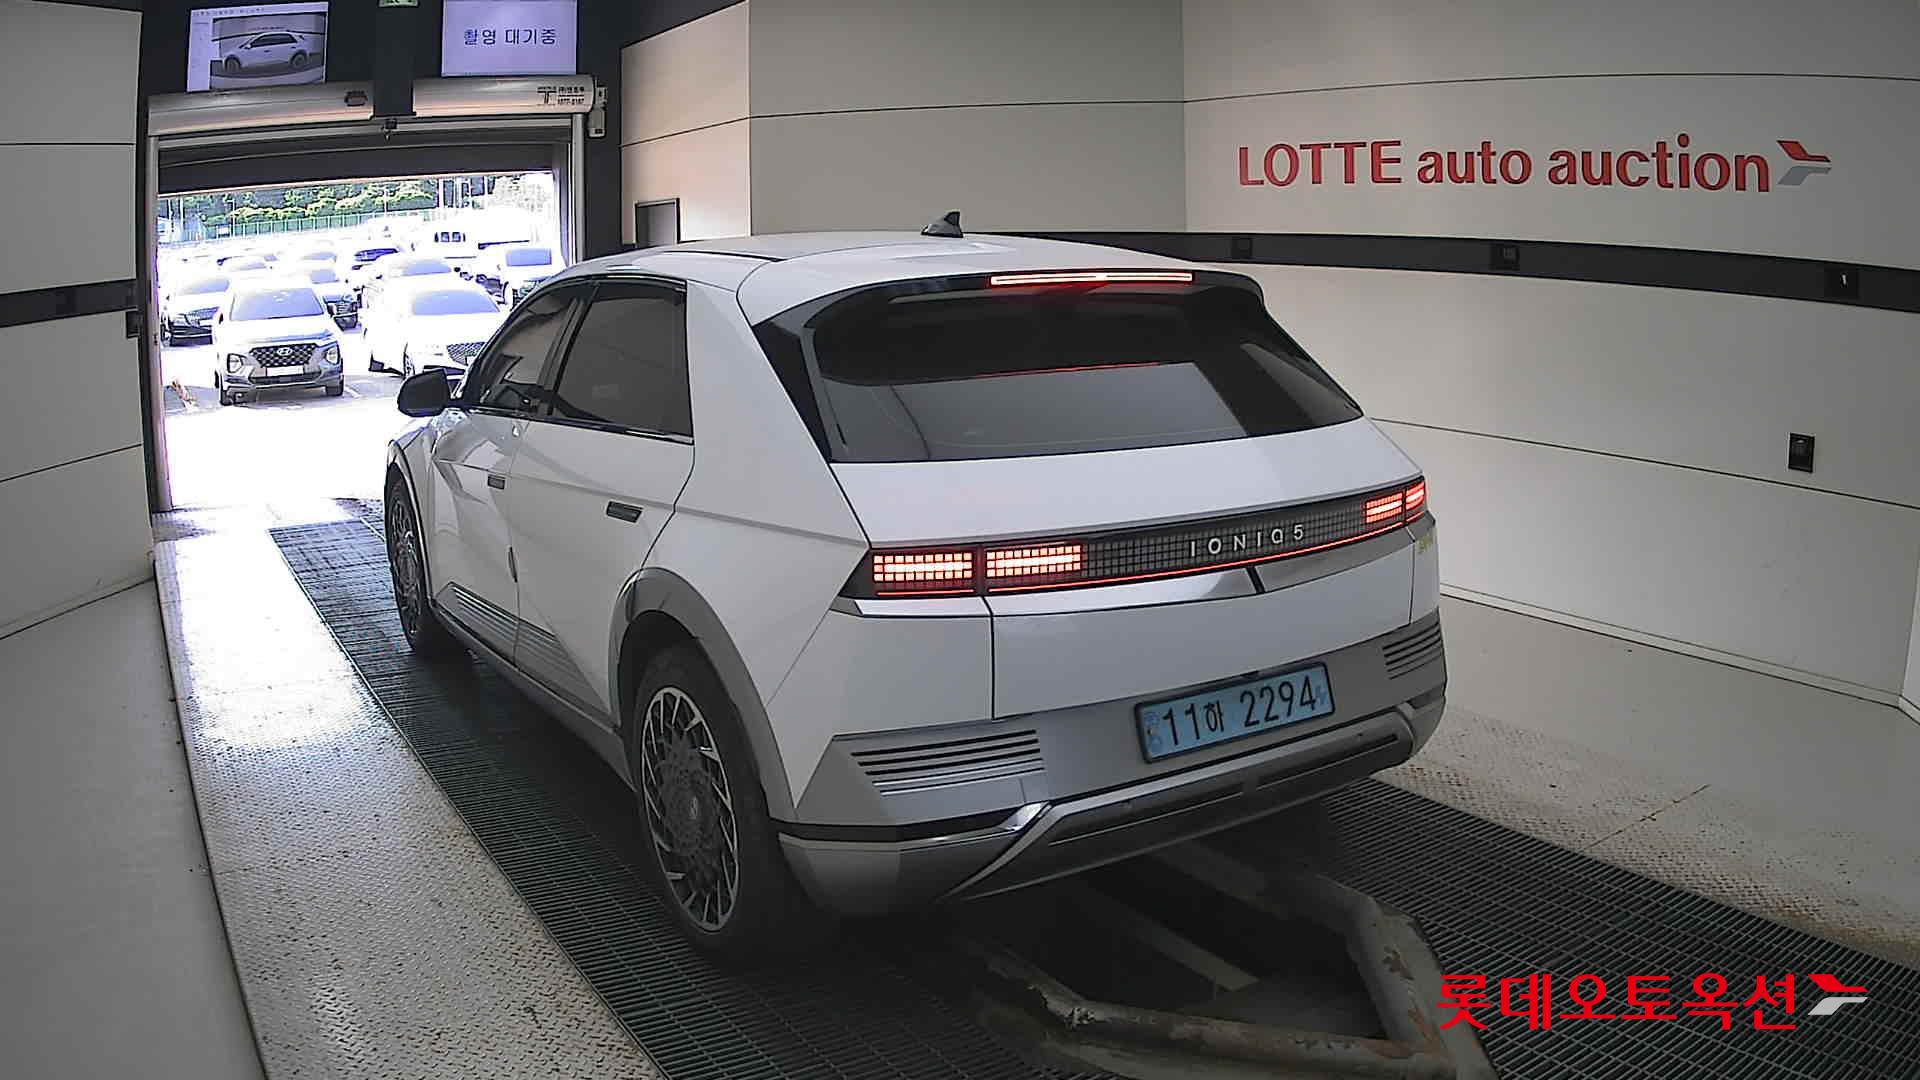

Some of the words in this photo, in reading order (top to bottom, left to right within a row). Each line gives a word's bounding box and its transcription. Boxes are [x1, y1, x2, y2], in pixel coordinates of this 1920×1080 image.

[464, 28, 497, 46] 촬영
[504, 28, 556, 45] 대기중
[1238, 140, 1402, 186] LOTTE
[1417, 140, 1533, 186] auto
[1548, 132, 1770, 193] auction
[1162, 700, 1225, 746] 11하
[1240, 674, 1317, 728] 2294
